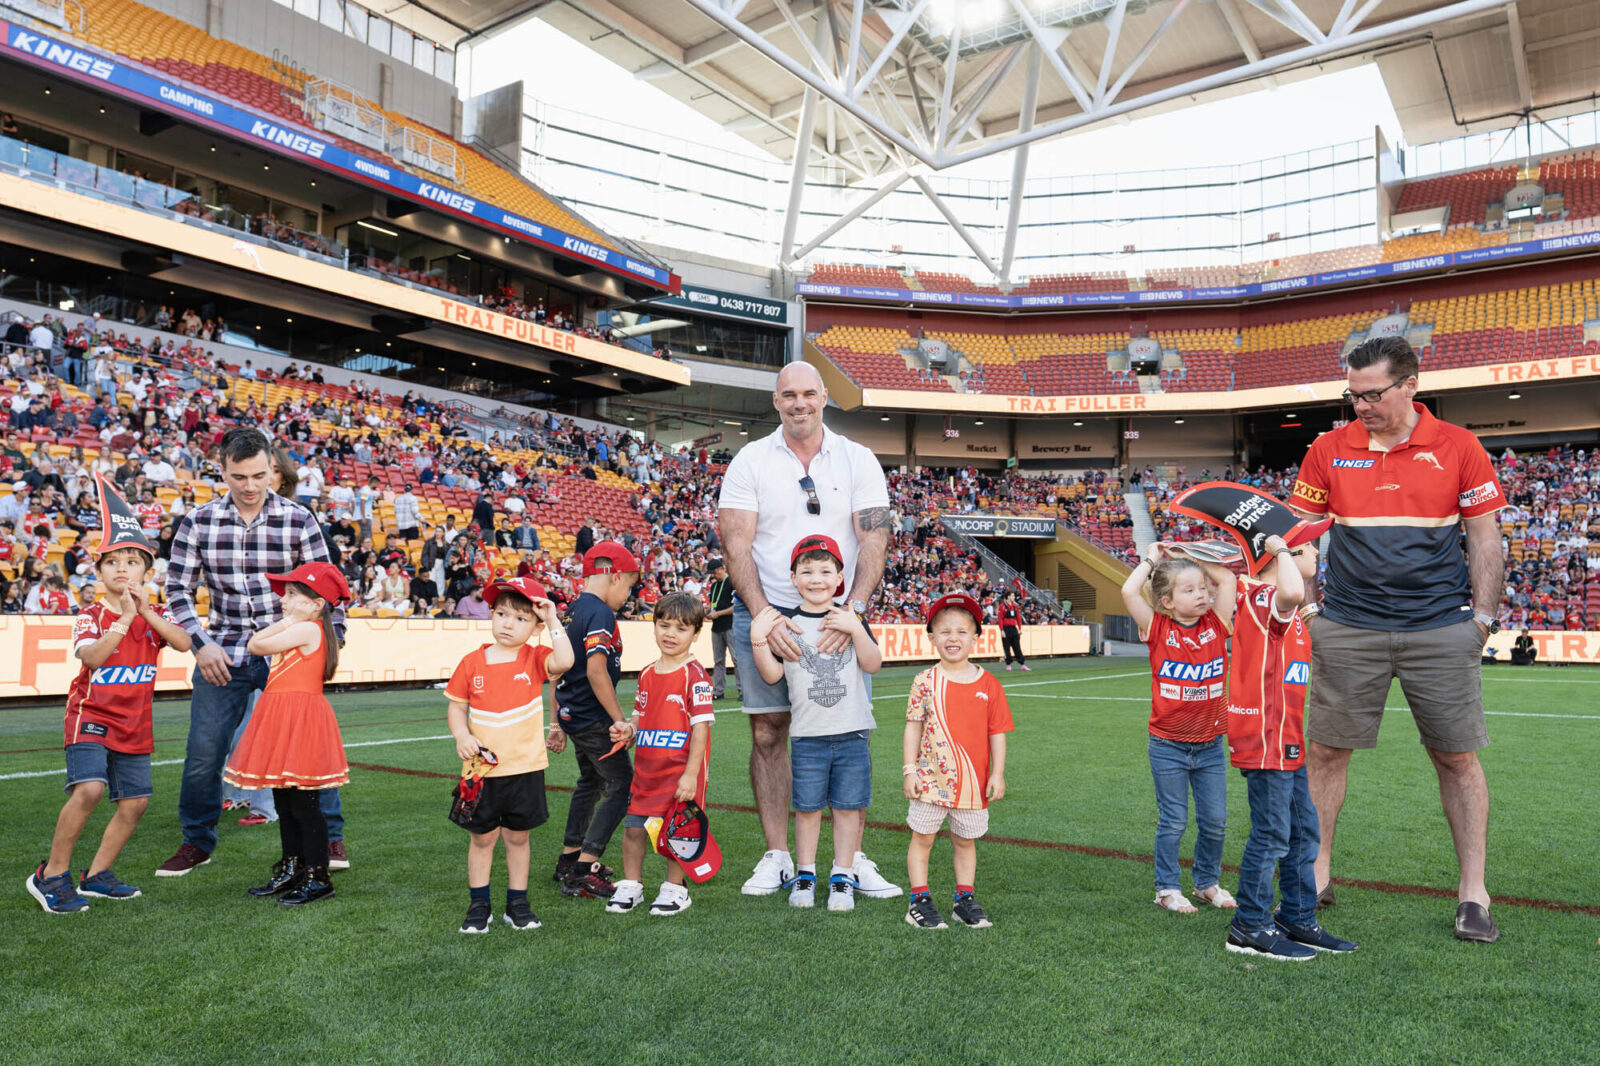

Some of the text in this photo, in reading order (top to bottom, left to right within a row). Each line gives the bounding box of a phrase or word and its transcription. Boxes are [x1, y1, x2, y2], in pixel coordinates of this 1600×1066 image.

[12, 32, 115, 80] KINGS
[160, 86, 214, 115] CAMPING
[251, 121, 326, 158] KINGS
[354, 160, 390, 180] 4WDING
[418, 183, 476, 214] KINGS
[502, 215, 543, 236] ADVENTURE
[563, 237, 608, 262] KINGS
[626, 260, 656, 278] OUTDOORS
[720, 297, 781, 317] 0438 717 807
[441, 300, 576, 352] TRAI FULLER
[1489, 360, 1559, 382] TRAI
[1007, 396, 1147, 412] TRAI FULLER
[945, 429, 960, 438] 336
[1124, 430, 1139, 440] 335
[966, 443, 997, 453] Market
[1032, 444, 1092, 454] Brewery Bar
[1332, 458, 1375, 468] KINGS
[1295, 482, 1327, 502] XXXX
[1224, 494, 1265, 527] Budget
[1238, 501, 1275, 531] Direct
[1011, 521, 1055, 533] STADIUM
[636, 730, 689, 748] INGS
